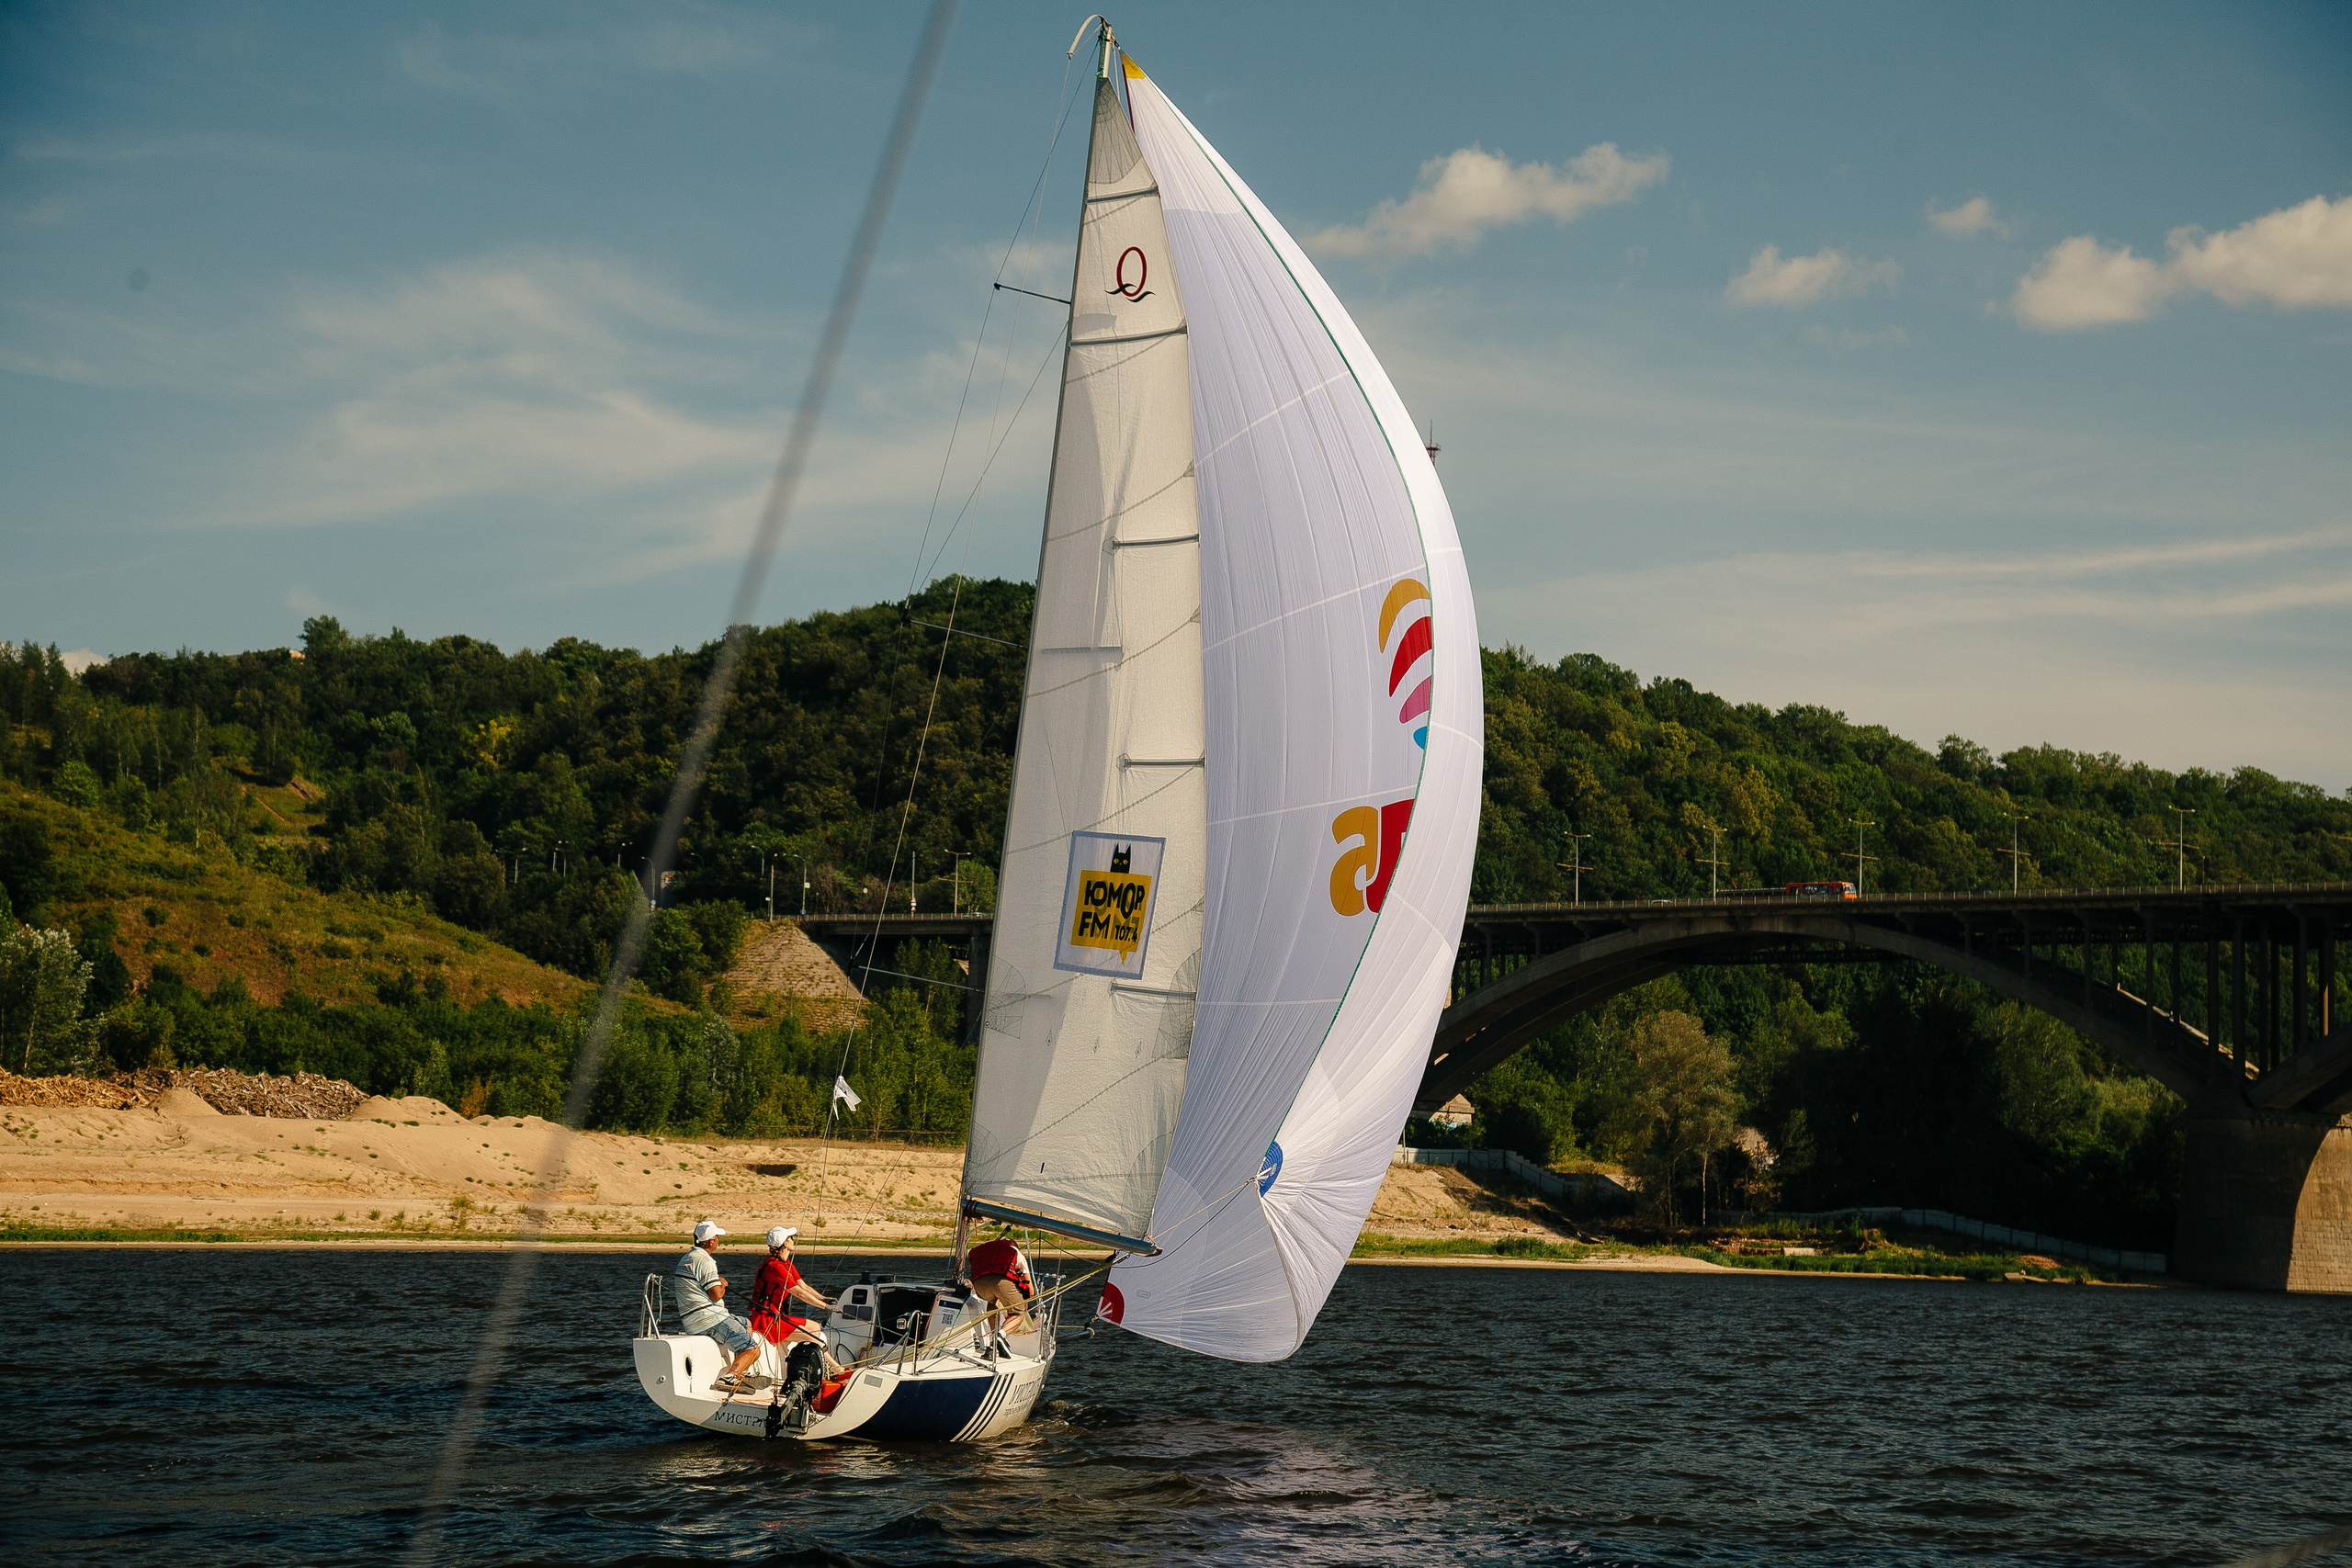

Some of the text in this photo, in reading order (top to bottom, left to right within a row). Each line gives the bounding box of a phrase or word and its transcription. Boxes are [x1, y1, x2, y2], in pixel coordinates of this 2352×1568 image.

[1084, 879, 1146, 919] ЮМОР
[1078, 910, 1138, 943] FM 107.4
